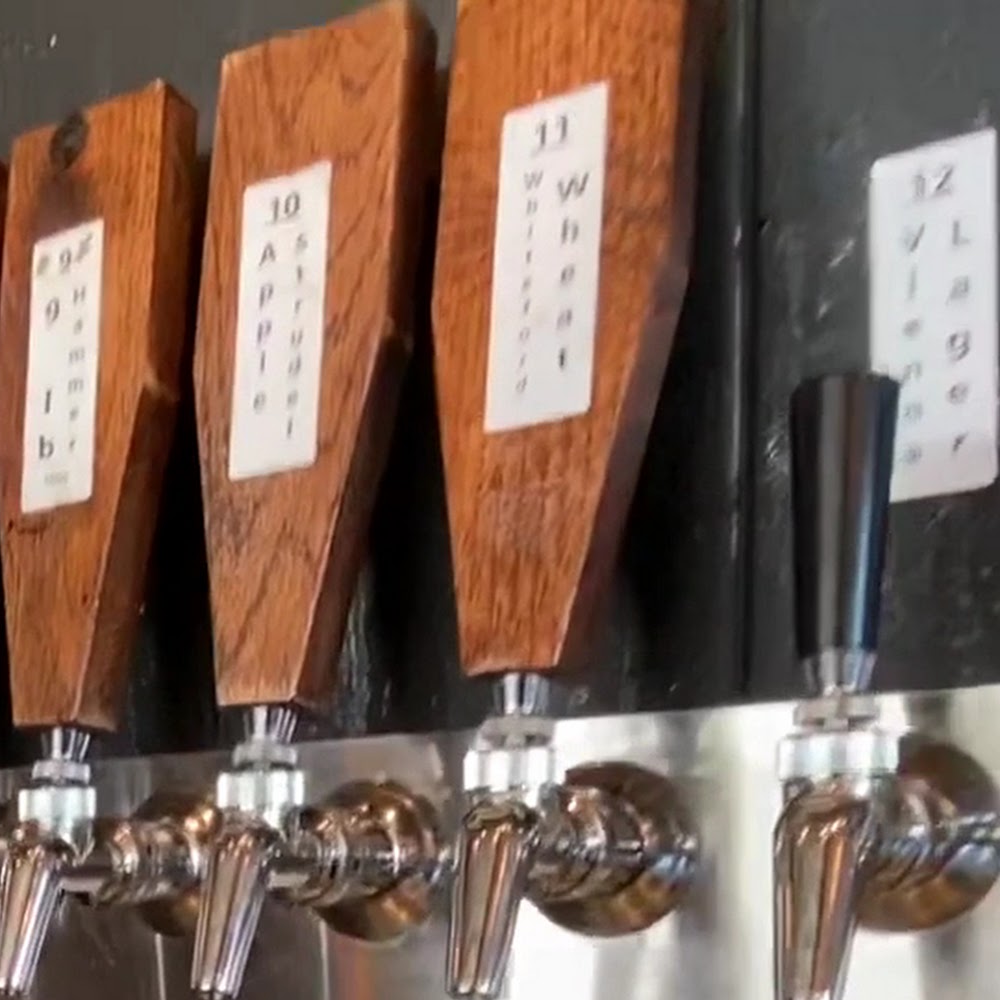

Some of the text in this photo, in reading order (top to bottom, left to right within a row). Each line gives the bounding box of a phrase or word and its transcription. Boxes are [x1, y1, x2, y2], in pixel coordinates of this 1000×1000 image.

[535, 115, 569, 149] 11
[912, 165, 955, 199] 12
[268, 190, 301, 222] 10
[253, 241, 277, 416] Apple
